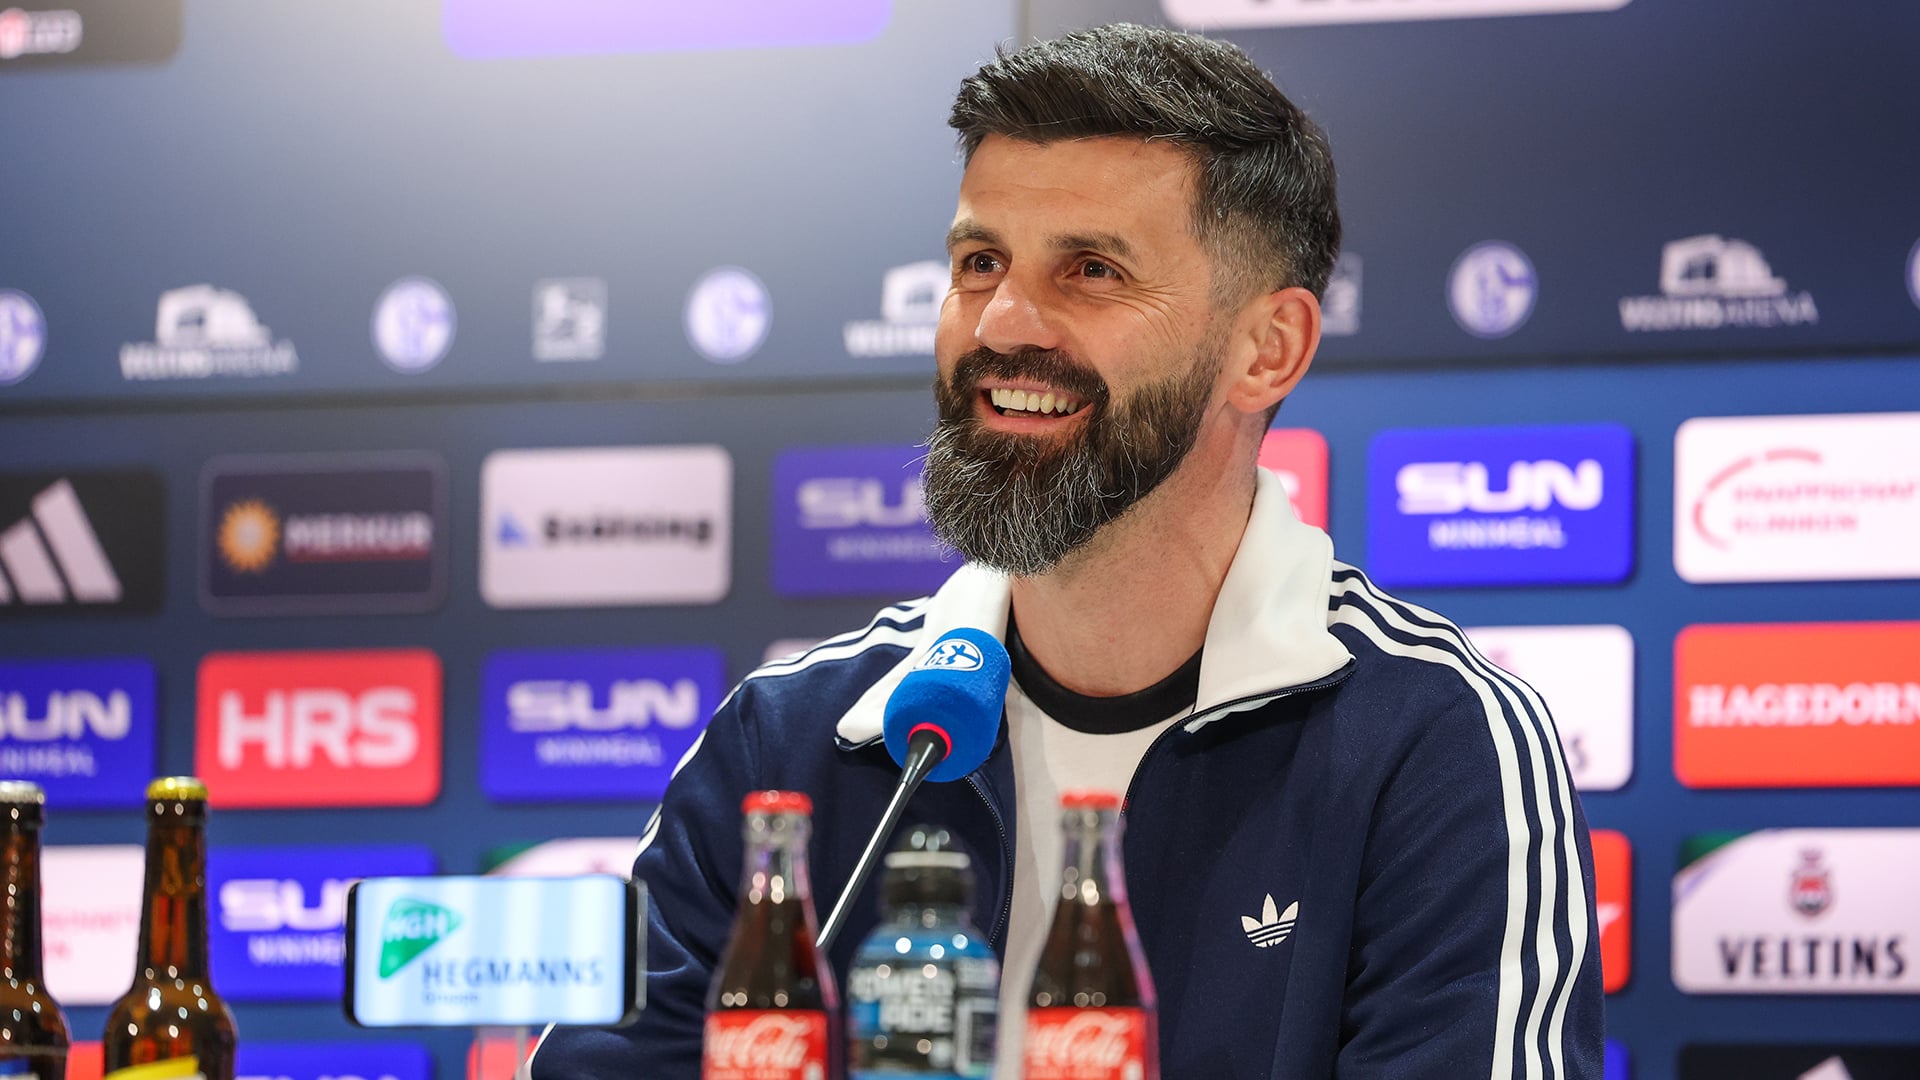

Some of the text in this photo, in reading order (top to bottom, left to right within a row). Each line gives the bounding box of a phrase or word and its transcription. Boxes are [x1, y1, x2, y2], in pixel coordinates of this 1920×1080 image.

[797, 476, 926, 530] SU
[1396, 458, 1604, 516] SUN
[0, 689, 132, 741] UN
[217, 687, 419, 769] HRS
[506, 679, 699, 733] SUN
[220, 879, 345, 931] SU
[422, 954, 604, 987] HEGMANNS
[1717, 935, 1907, 980] VELTINS
